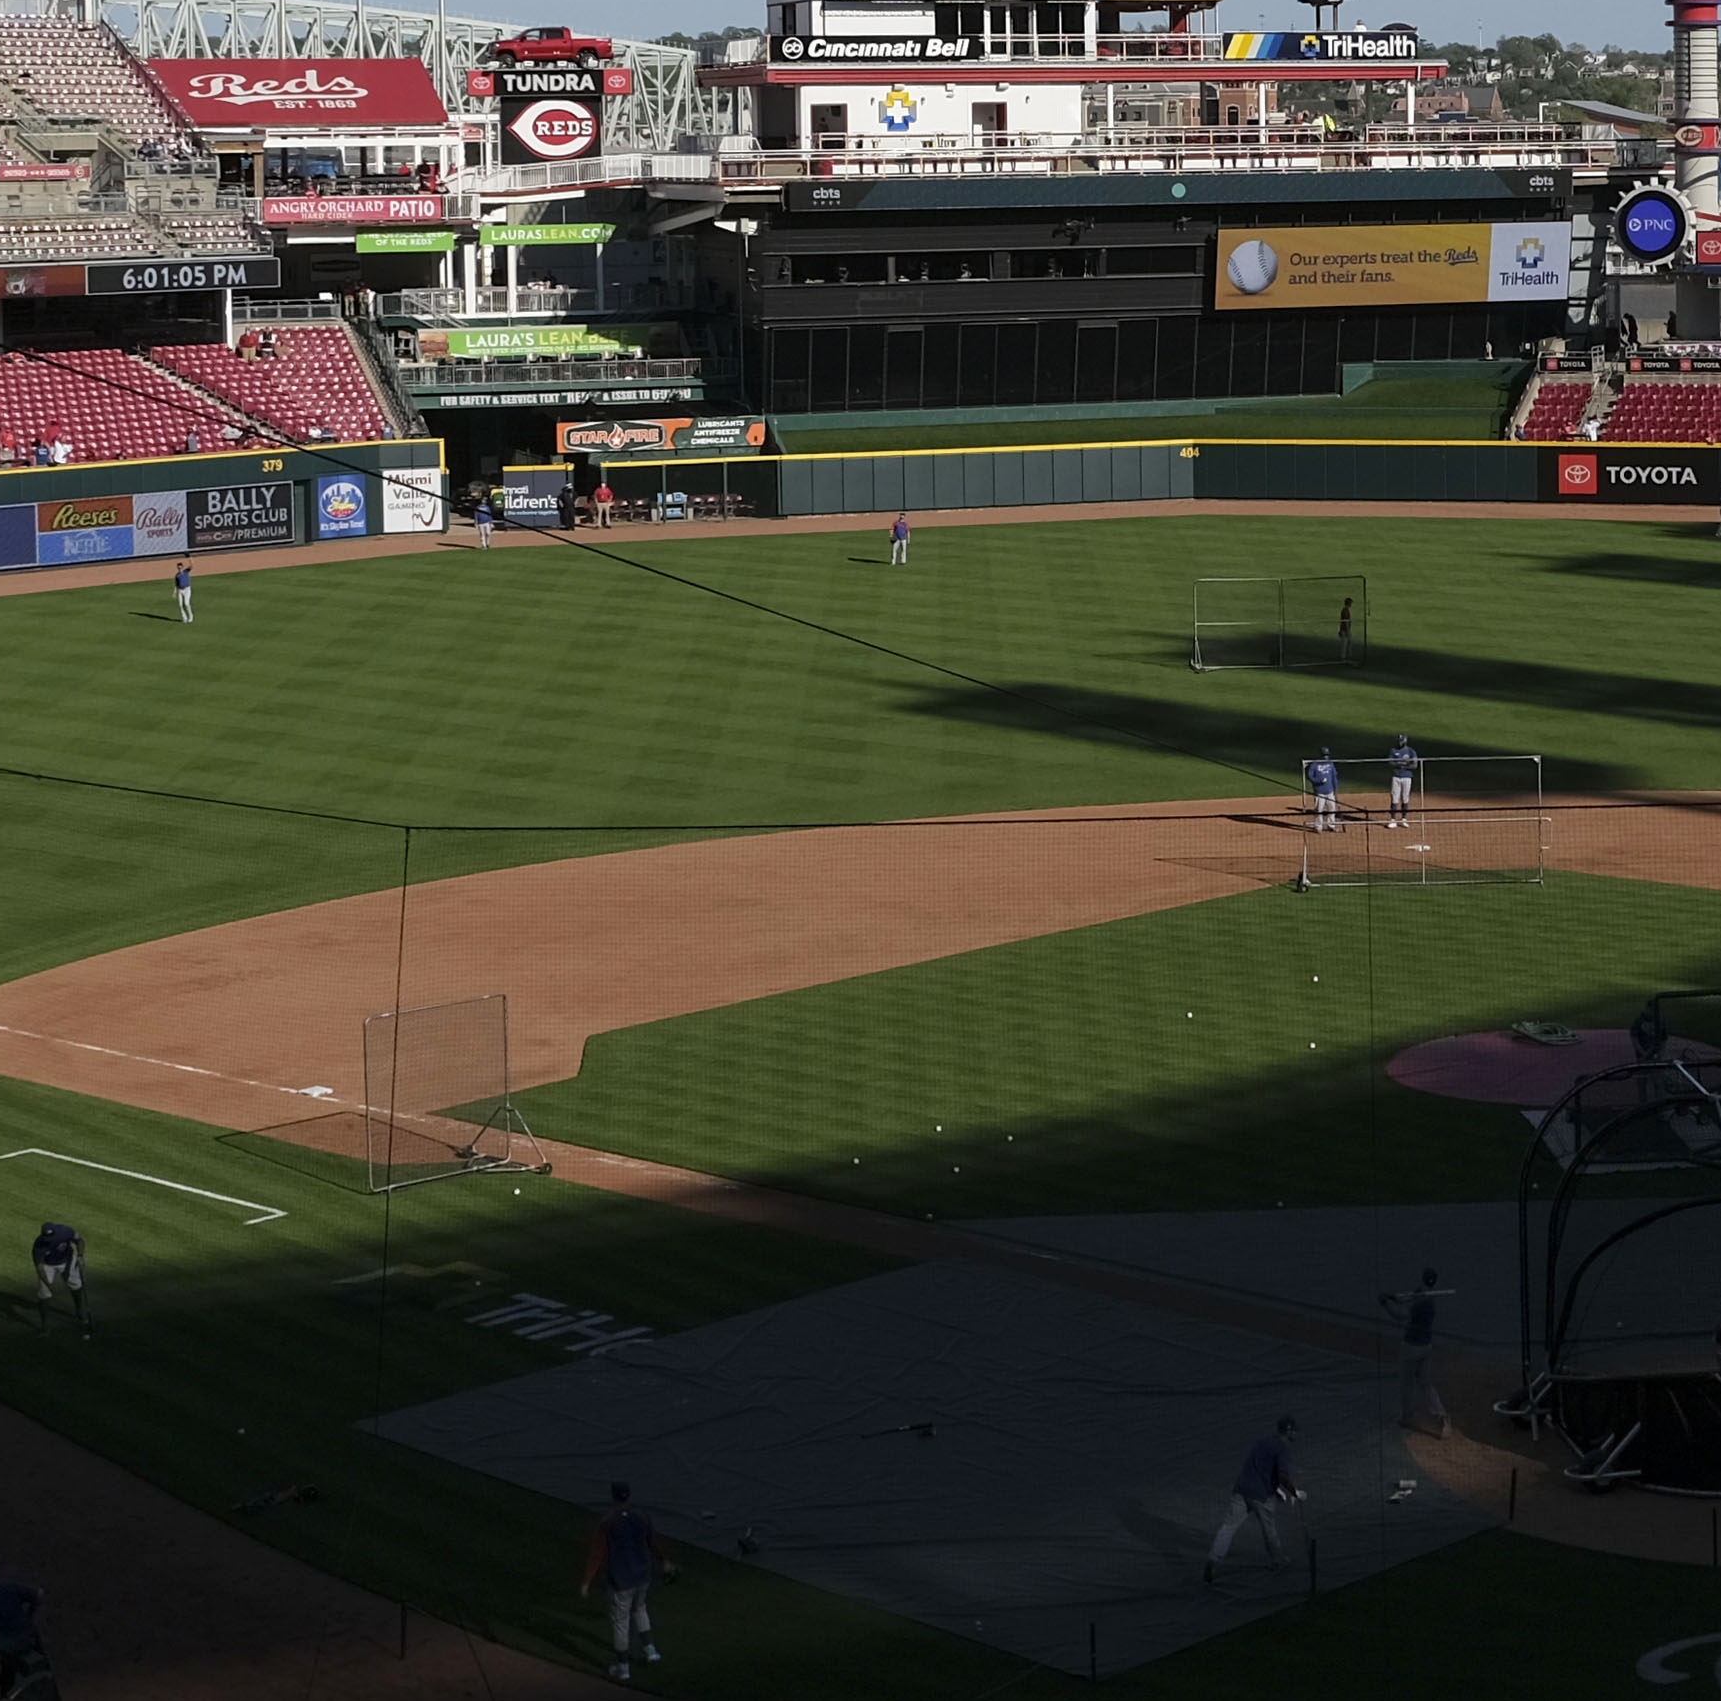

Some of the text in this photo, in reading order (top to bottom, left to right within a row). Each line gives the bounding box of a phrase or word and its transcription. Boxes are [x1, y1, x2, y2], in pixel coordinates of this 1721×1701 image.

[808, 37, 969, 58] Cincinnati Bell
[1325, 34, 1416, 58] TriHealth
[188, 69, 368, 106] Reds
[502, 73, 596, 92] TUNDRA
[274, 99, 357, 109] EST. 1869
[535, 120, 594, 136] REDS
[1529, 175, 1554, 187] cbts
[812, 187, 840, 199] cbts
[270, 199, 435, 217] ANGRY ORCHARD PATIO
[1644, 219, 1673, 231] PNC
[1290, 247, 1478, 268] Our experts treat the Reds
[122, 262, 247, 289] 6:01:05 PM
[1289, 268, 1395, 285] and their fans.
[1499, 271, 1559, 286] TriHealth
[465, 331, 584, 348] LAURA'S LEAN
[459, 395, 491, 406] SAFETY
[539, 392, 560, 403] TEXT
[569, 428, 660, 445] STAR FIRE
[261, 458, 283, 472] 379
[388, 473, 432, 486] Miami
[1606, 466, 1697, 485] TOYOTA
[207, 486, 276, 513] BALLY
[52, 502, 117, 529] Reese's
[136, 507, 184, 531] Bally
[194, 508, 288, 529] SPORTS CLUB
[232, 526, 287, 541] /PREMIUM
